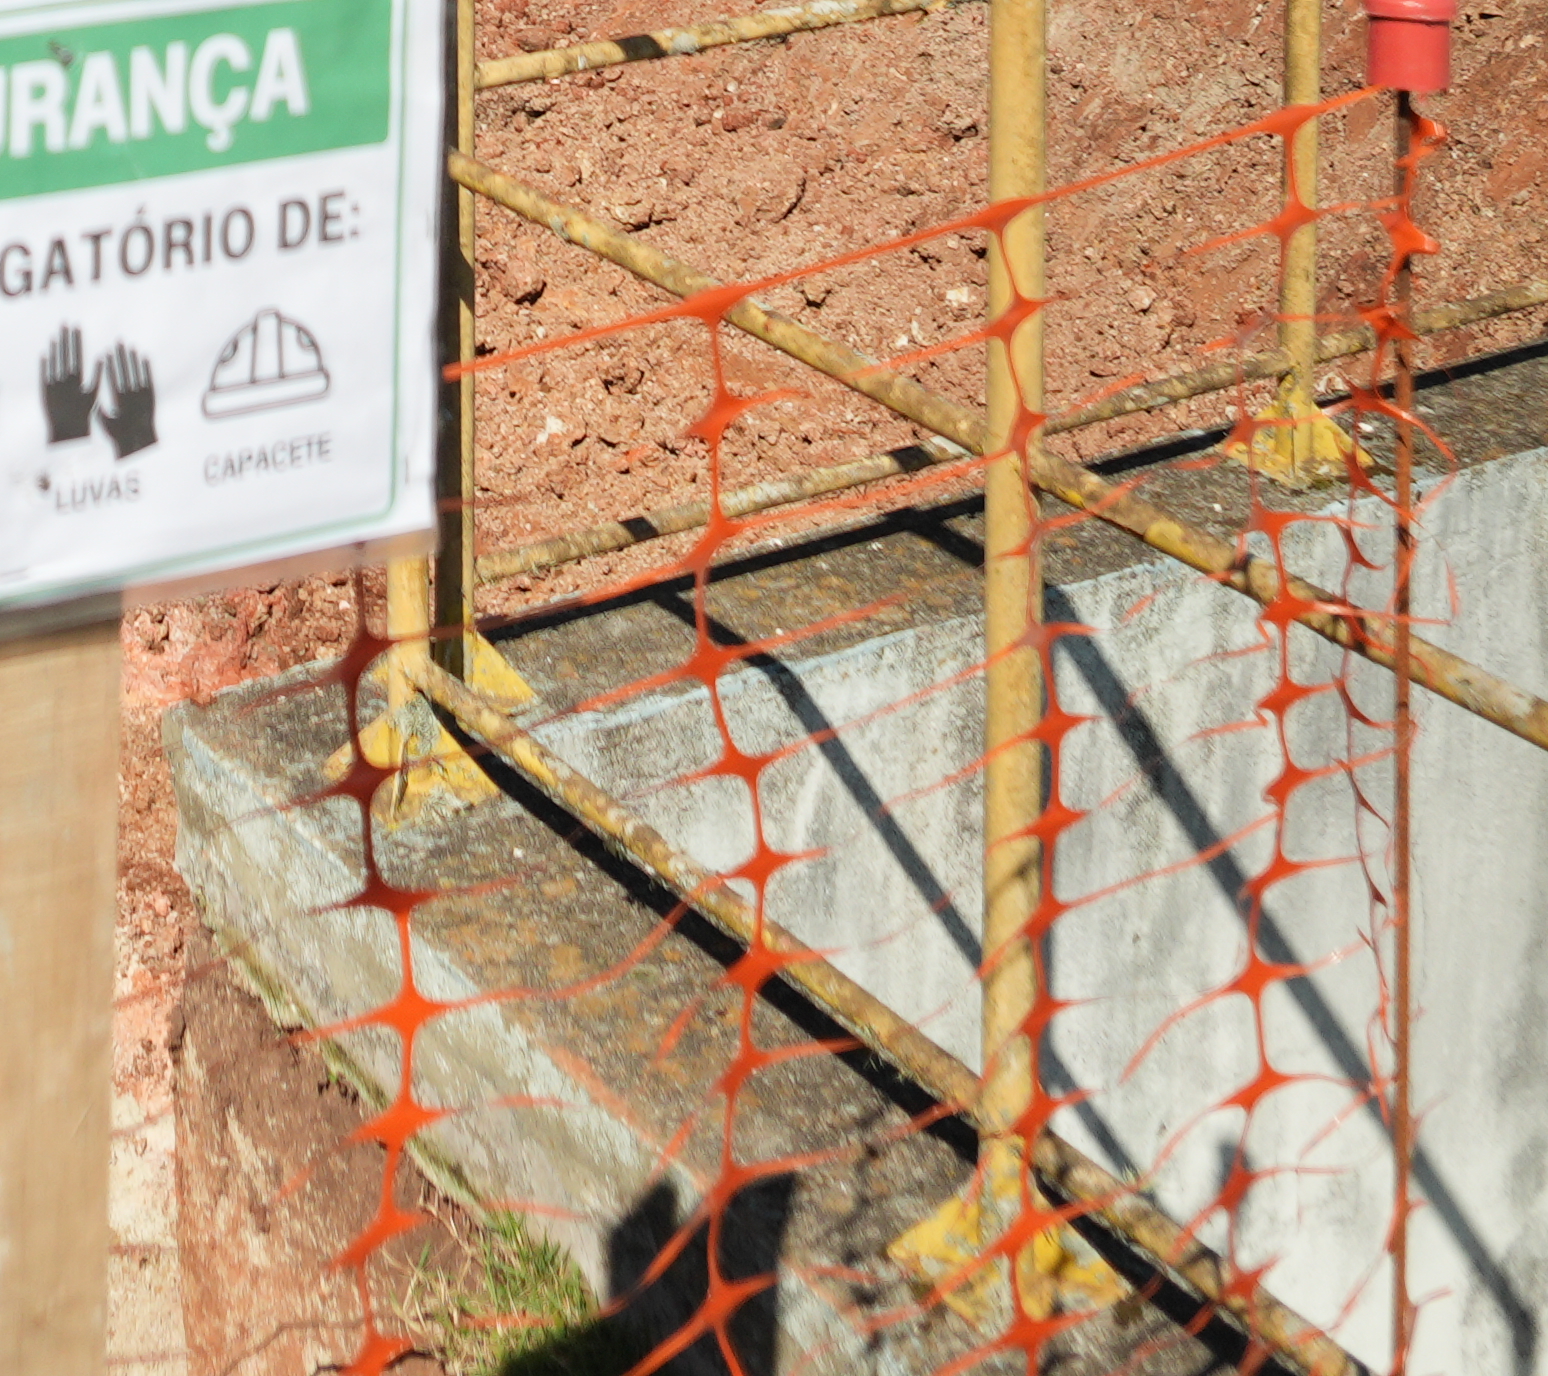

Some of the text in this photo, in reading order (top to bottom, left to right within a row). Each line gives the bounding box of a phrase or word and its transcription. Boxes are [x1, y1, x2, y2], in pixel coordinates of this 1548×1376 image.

[276, 190, 362, 252] DE:
[203, 431, 333, 484] CAPACETE
[54, 470, 141, 513] LUVAS
